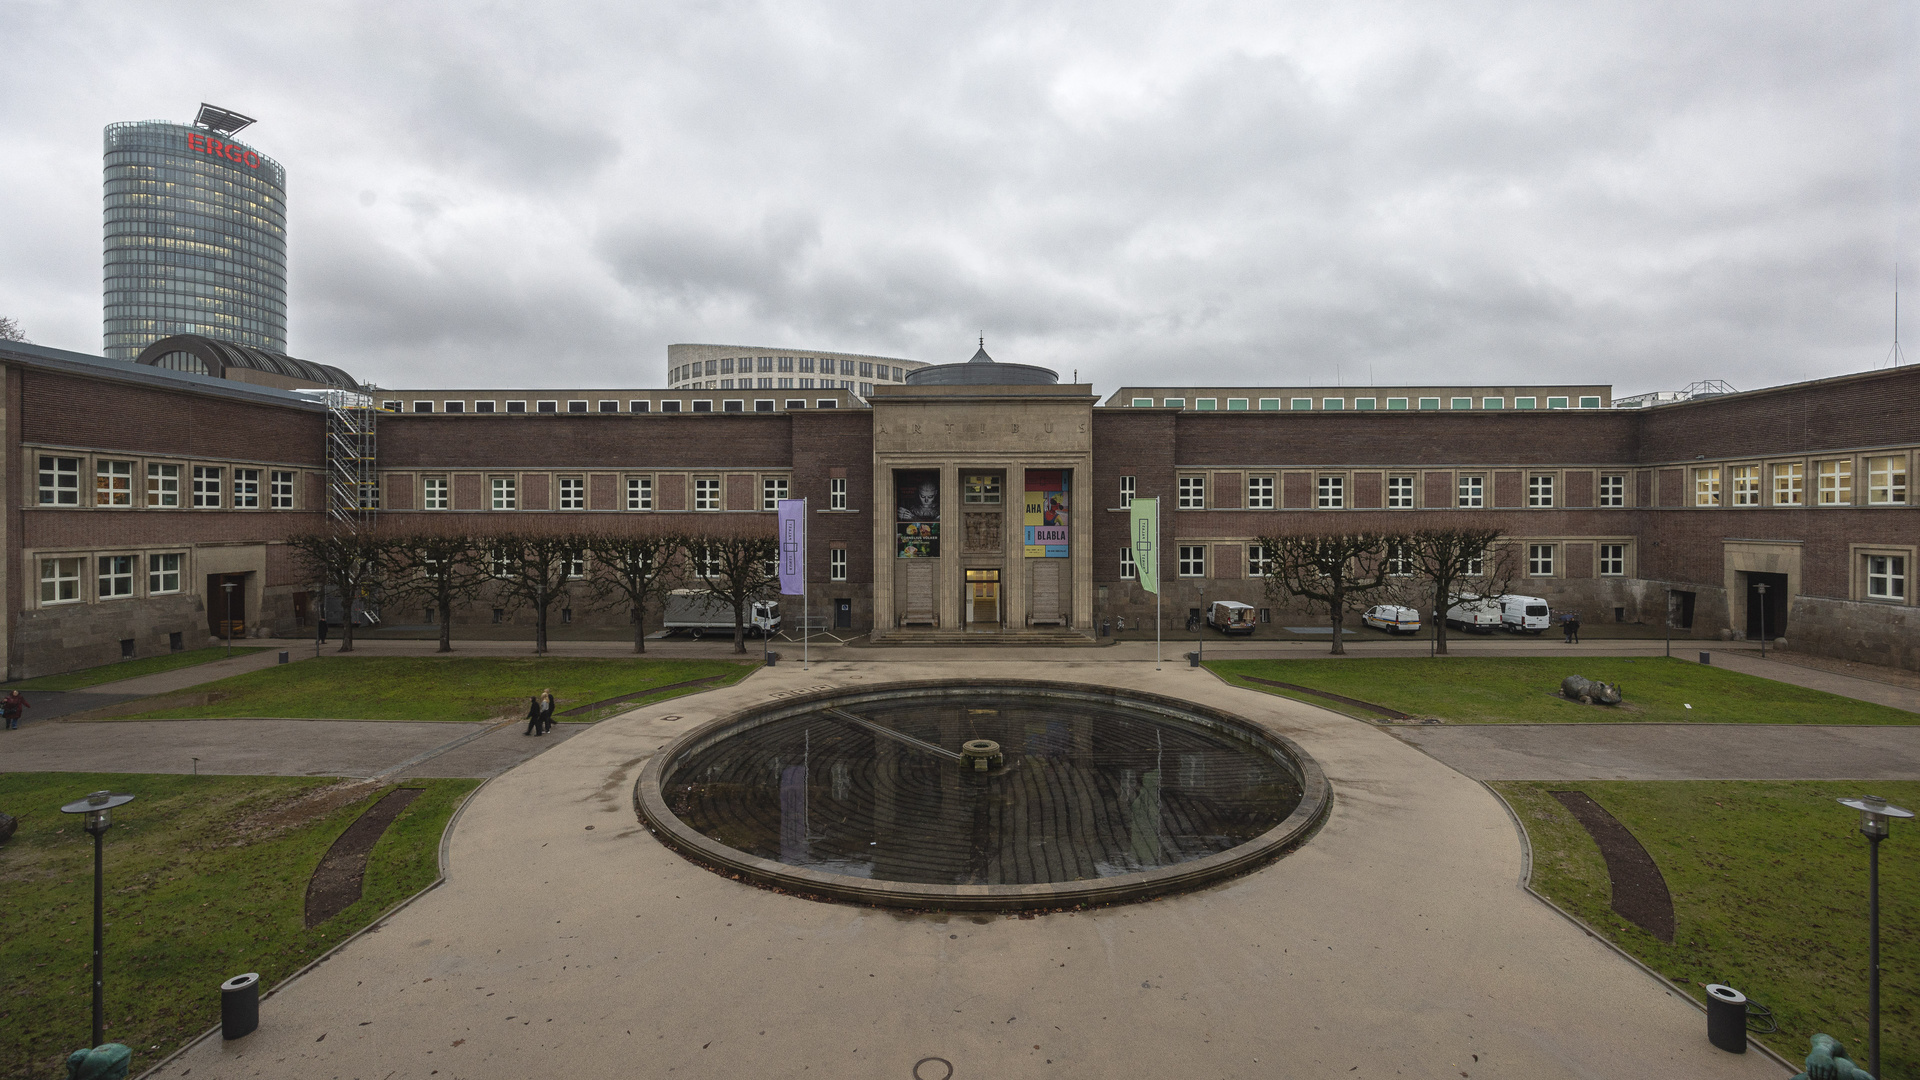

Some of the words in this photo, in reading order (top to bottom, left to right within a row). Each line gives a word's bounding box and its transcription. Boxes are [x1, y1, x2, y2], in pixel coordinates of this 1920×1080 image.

[188, 132, 261, 169] ERGO
[879, 423, 1086, 434] ARTIBUS
[1026, 503, 1042, 514] AHA
[1037, 530, 1066, 541] BLABLA
